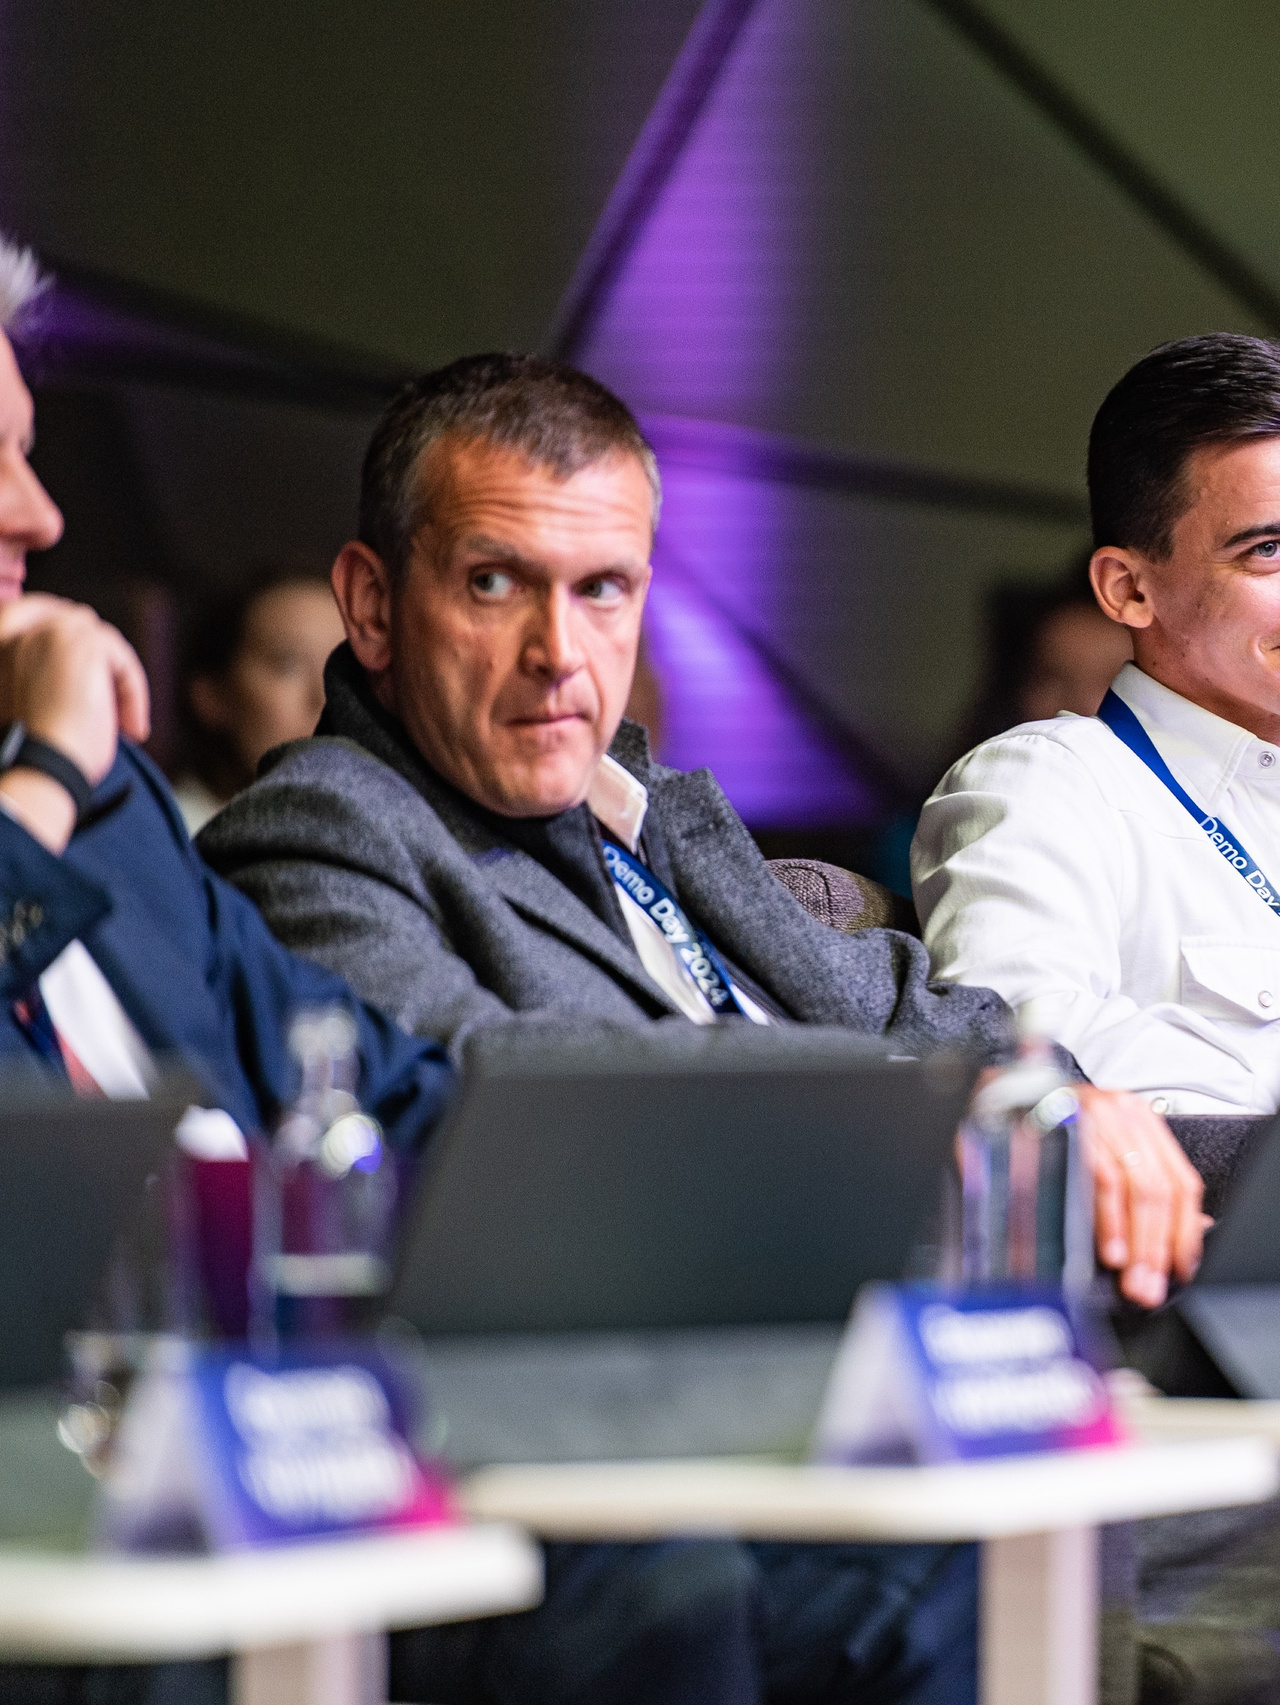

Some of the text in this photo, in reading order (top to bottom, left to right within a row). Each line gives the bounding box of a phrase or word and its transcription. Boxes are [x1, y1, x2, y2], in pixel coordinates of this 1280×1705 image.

[1200, 817, 1248, 870] Demo
[1244, 870, 1280, 908] Day
[602, 846, 730, 1006] Demo Day 2024
